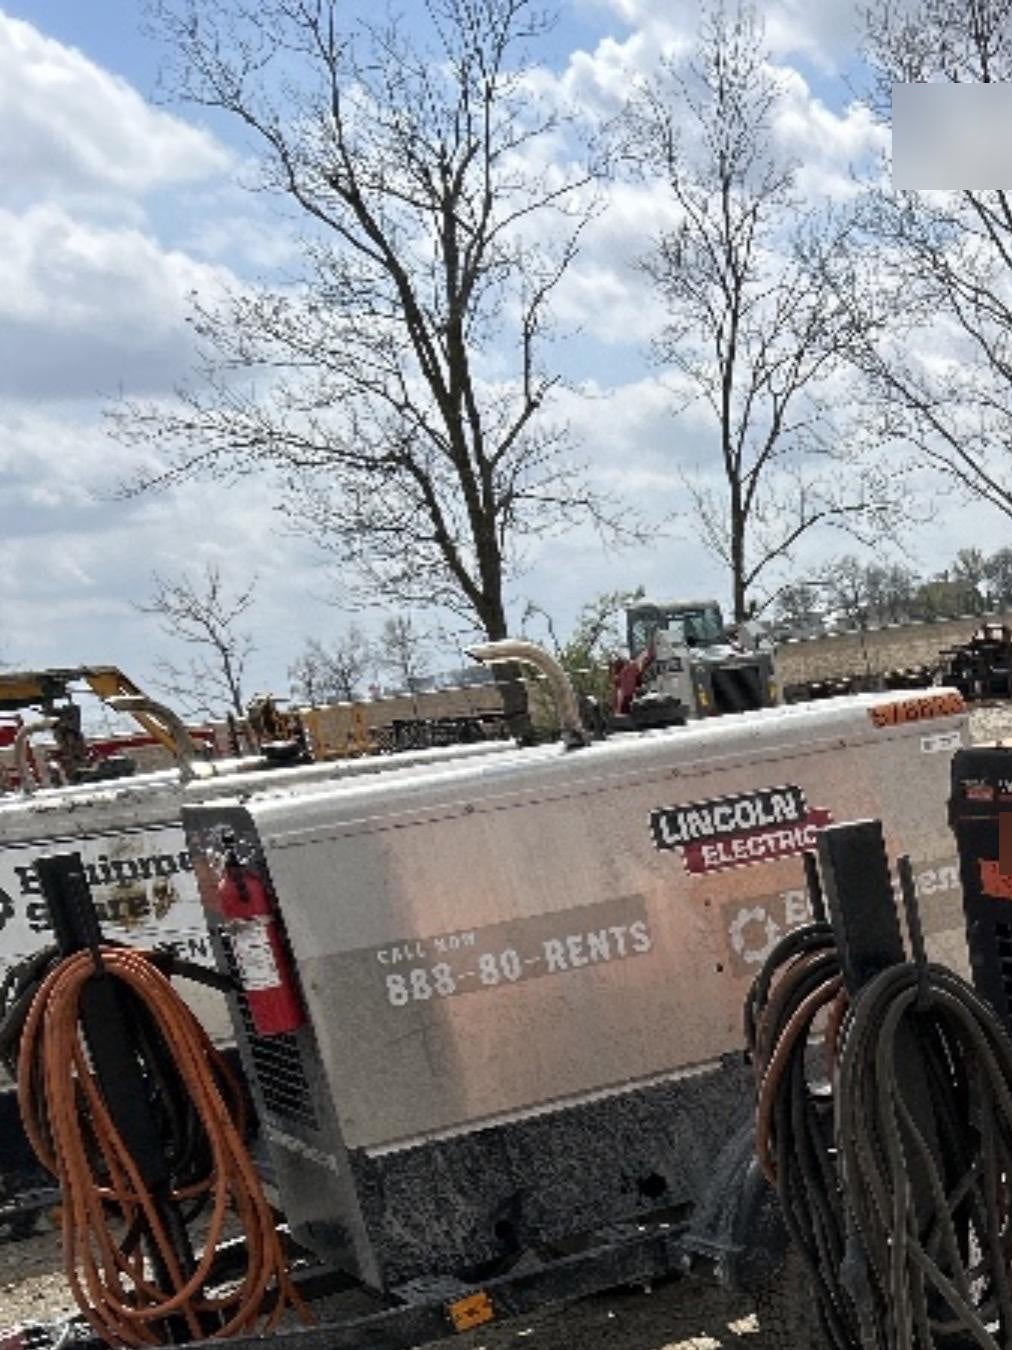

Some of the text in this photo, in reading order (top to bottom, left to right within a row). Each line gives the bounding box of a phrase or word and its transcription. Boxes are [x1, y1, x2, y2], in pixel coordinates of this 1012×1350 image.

[658, 791, 799, 844] LINCOLN
[701, 824, 817, 867] ELECTRIC
[377, 940, 427, 965] CALL
[386, 919, 653, 1006] 888-80-RENTS
